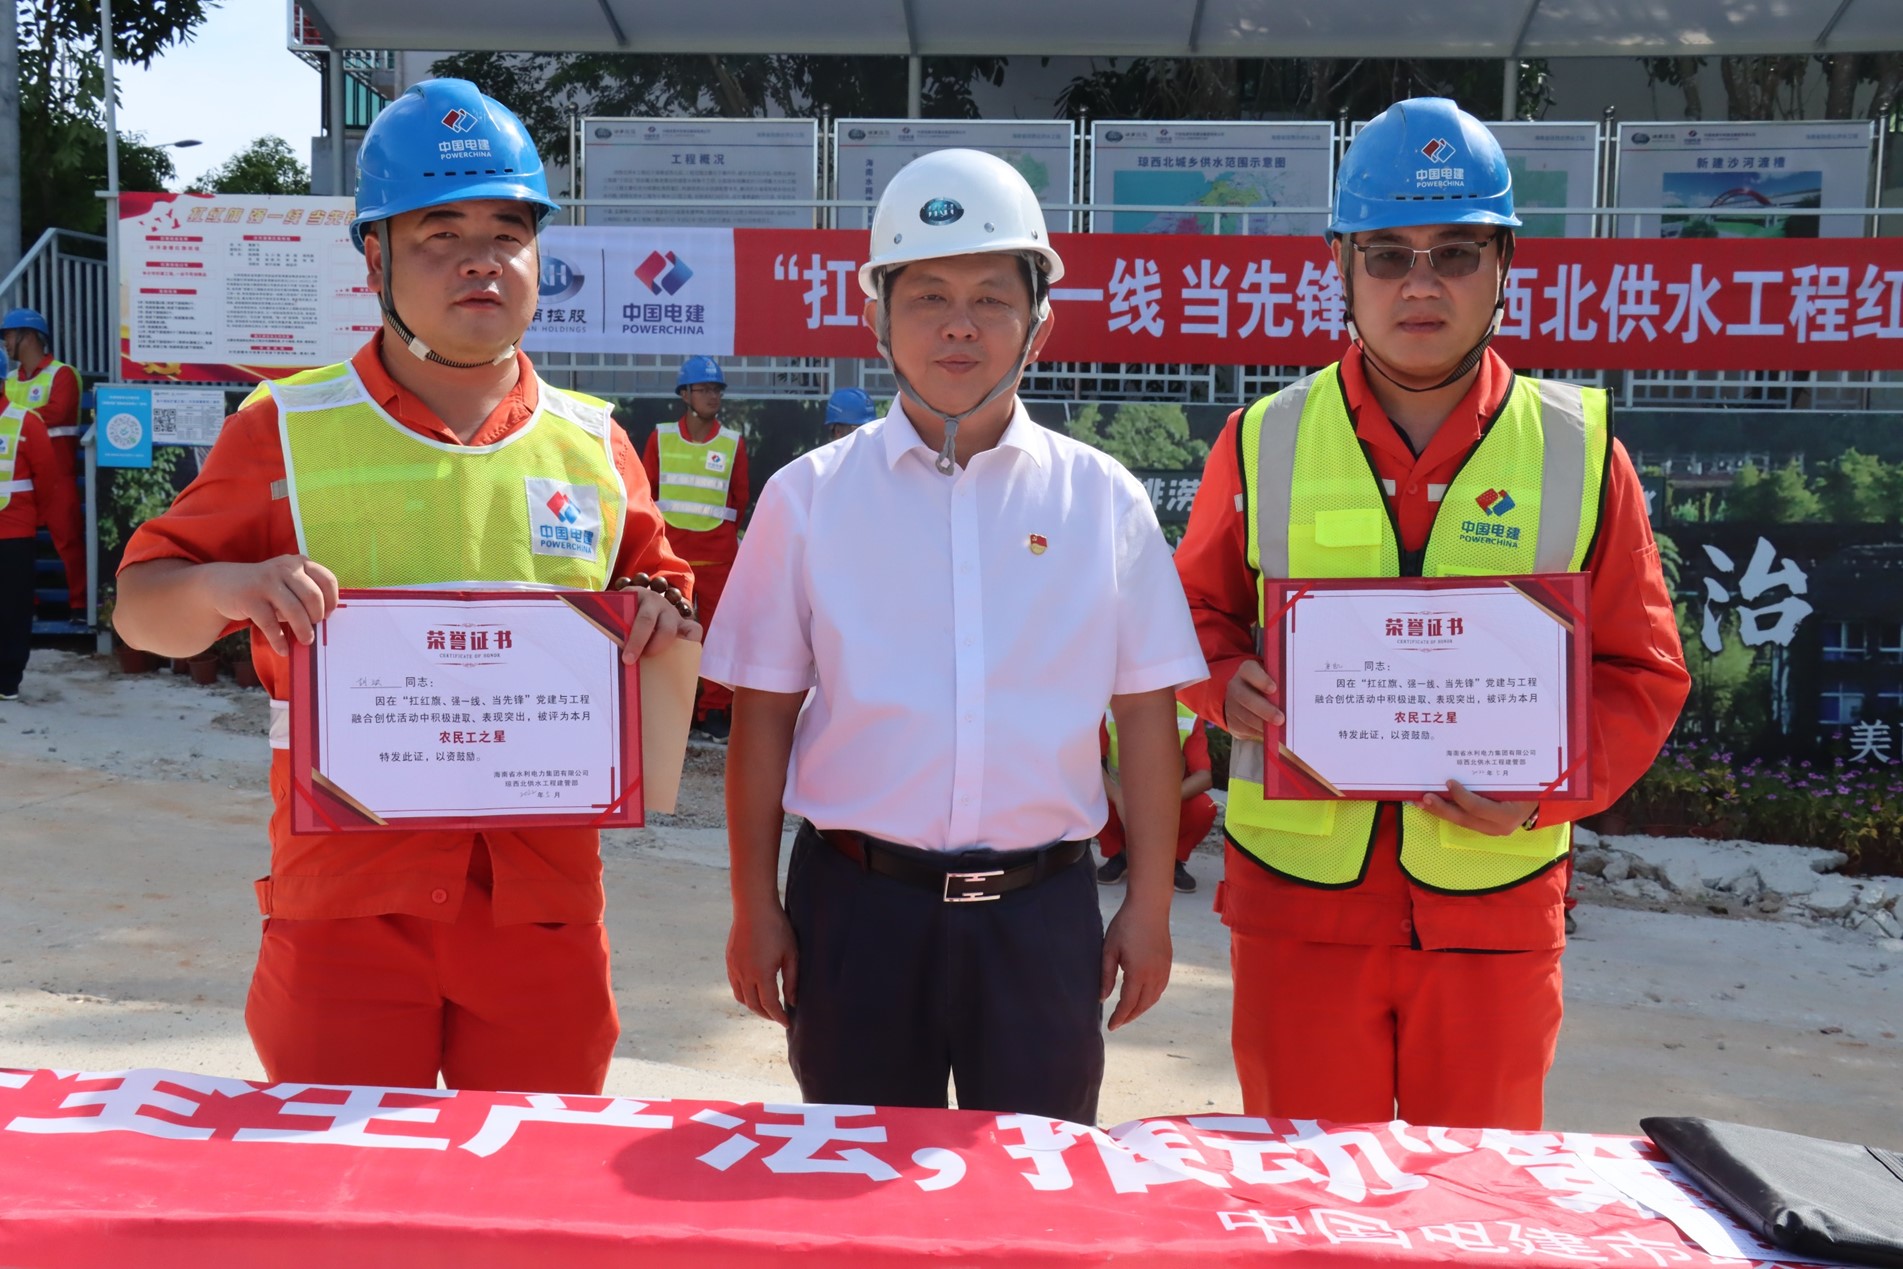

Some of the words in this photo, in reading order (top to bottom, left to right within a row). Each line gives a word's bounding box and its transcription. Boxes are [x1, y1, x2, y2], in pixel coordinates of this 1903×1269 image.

[438, 139, 491, 152] 中国电建
[440, 151, 492, 160] POWERCHINA
[1137, 156, 1286, 168] 琼西北城乡供水范围示意图
[1415, 168, 1465, 181] 中国电建
[1416, 180, 1465, 188] POWERCHINA
[622, 302, 706, 323] 中国电建
[541, 326, 587, 334] HOLDINGS
[622, 324, 705, 335] POWERCHINA
[540, 525, 594, 545] 中国电建
[1461, 520, 1521, 540] 中国电建
[540, 540, 592, 554] POWERCHINA
[1459, 534, 1519, 548] POWERCHINA
[1701, 536, 1814, 652] 治
[1385, 617, 1464, 636] 荣誉证书
[427, 630, 512, 650] 荣誉证书
[1394, 711, 1458, 724] 农民工之星
[439, 730, 506, 744] 农民工之星
